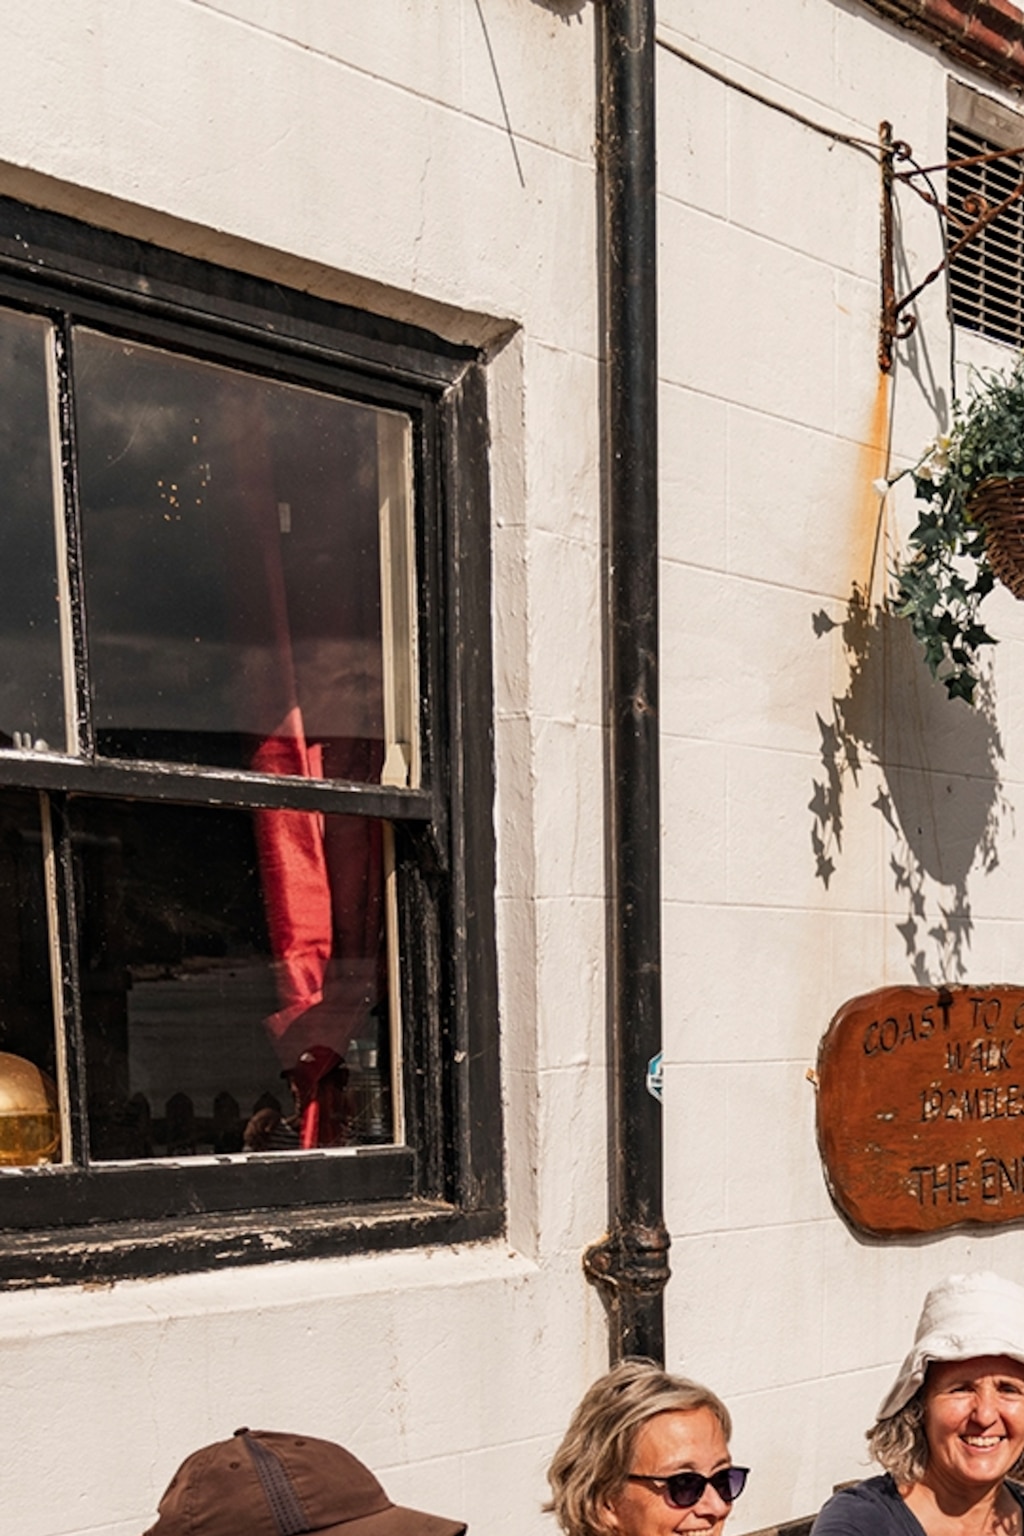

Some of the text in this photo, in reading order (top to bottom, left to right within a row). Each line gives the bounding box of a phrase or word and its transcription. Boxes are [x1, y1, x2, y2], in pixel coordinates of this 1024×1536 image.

[862, 1002, 952, 1056] COAST
[968, 997, 1002, 1032] TO
[945, 1039, 1013, 1073] WALK
[909, 1161, 970, 1206] THE
